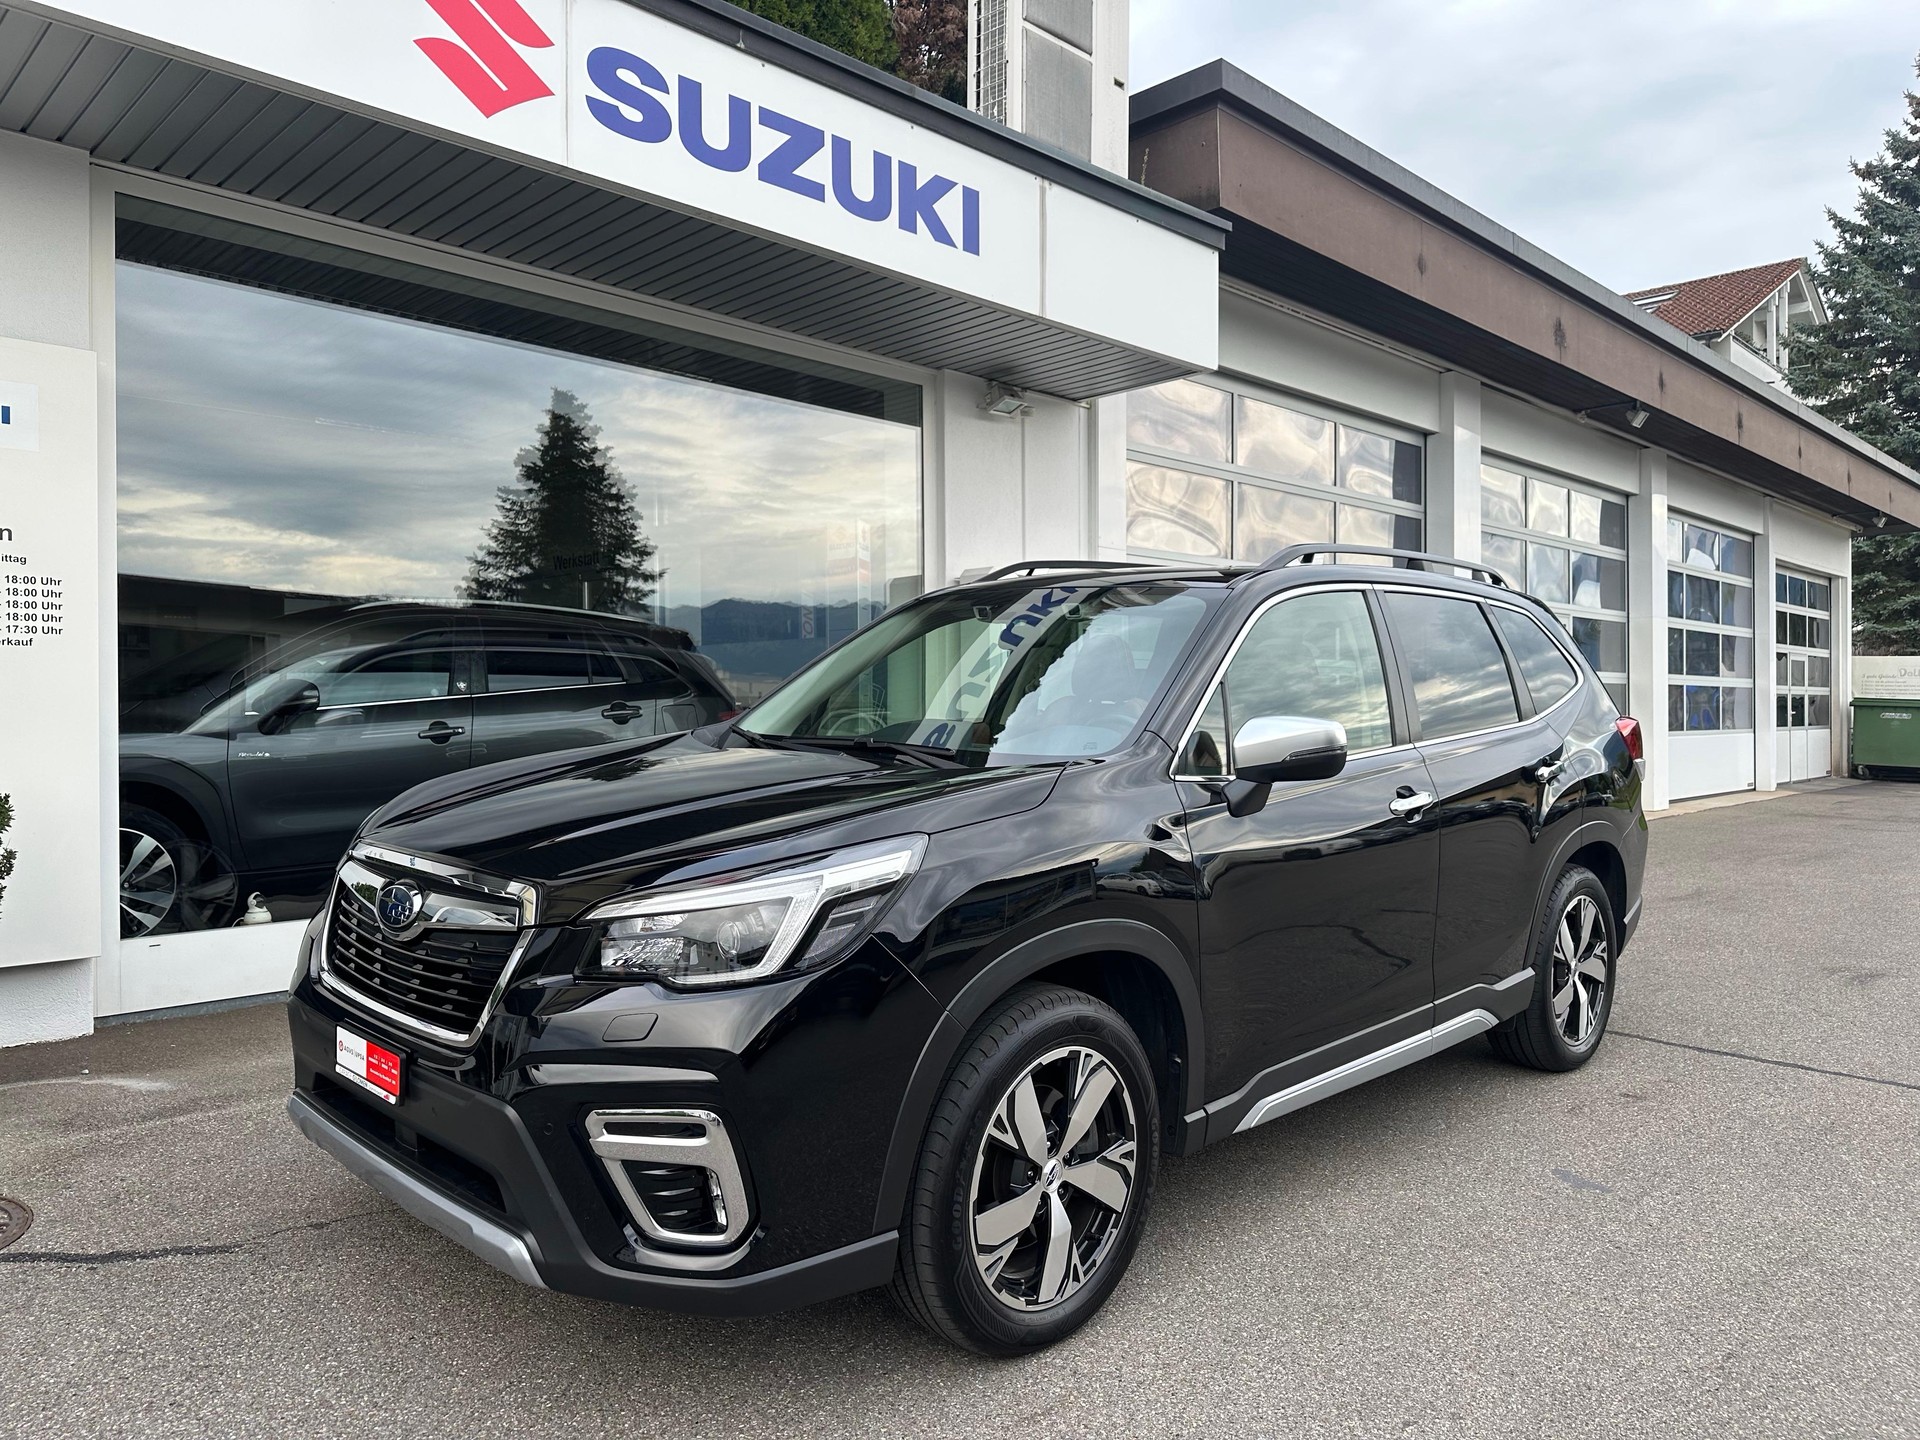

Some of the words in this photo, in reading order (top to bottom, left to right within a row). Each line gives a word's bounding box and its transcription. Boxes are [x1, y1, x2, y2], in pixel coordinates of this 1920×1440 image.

[585, 46, 981, 257] SUZUKI
[4, 574, 37, 585] 18:00
[40, 576, 63, 587] Uhr
[5, 587, 38, 598] 18:00
[41, 588, 63, 599] Uhr
[5, 599, 38, 610] 18:00
[41, 601, 63, 611] Uhr
[5, 612, 38, 622] 18:00
[41, 613, 64, 623] Uhr
[5, 624, 38, 635] 17:30
[41, 625, 64, 635] Uhr
[0, 636, 34, 647] rkauf
